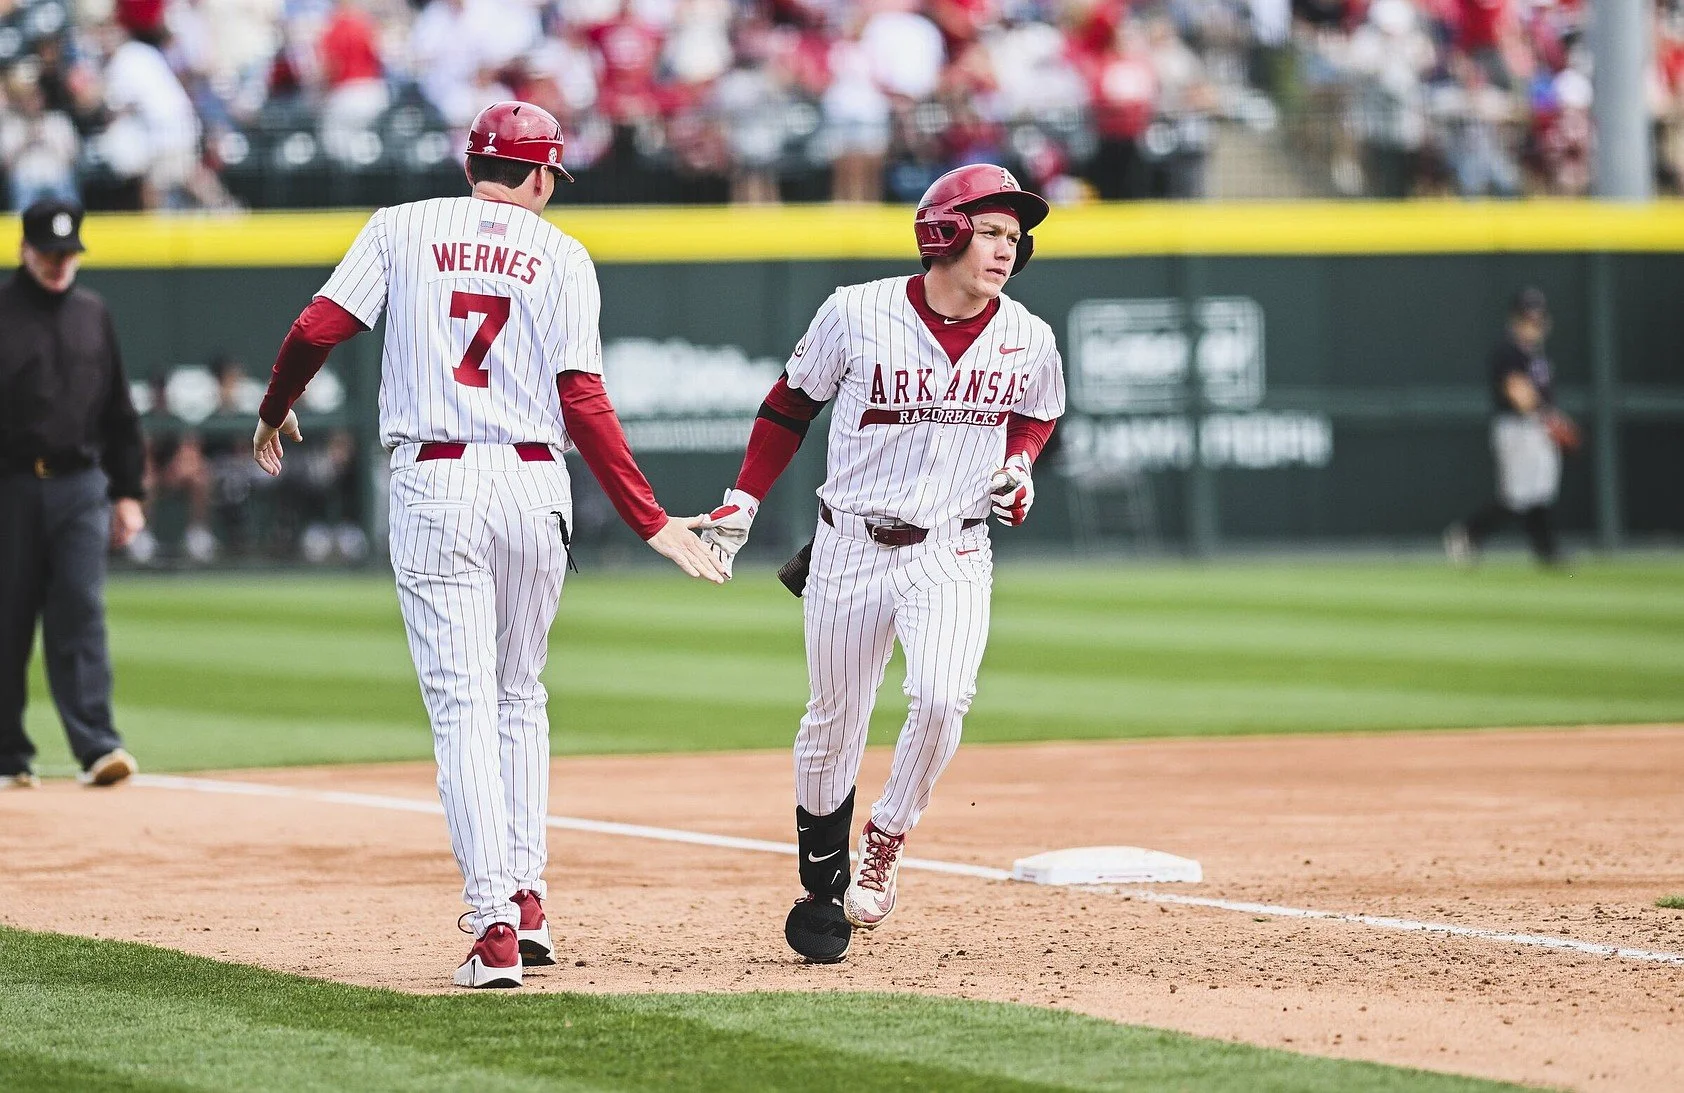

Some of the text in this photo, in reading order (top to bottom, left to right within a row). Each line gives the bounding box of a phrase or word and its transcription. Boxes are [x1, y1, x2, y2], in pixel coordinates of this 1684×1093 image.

[488, 132, 497, 145] 7
[432, 243, 541, 285] WERNES
[449, 291, 511, 388] 7
[870, 364, 1029, 404] ARKANSAS
[899, 411, 999, 425] RAZORBACKS
